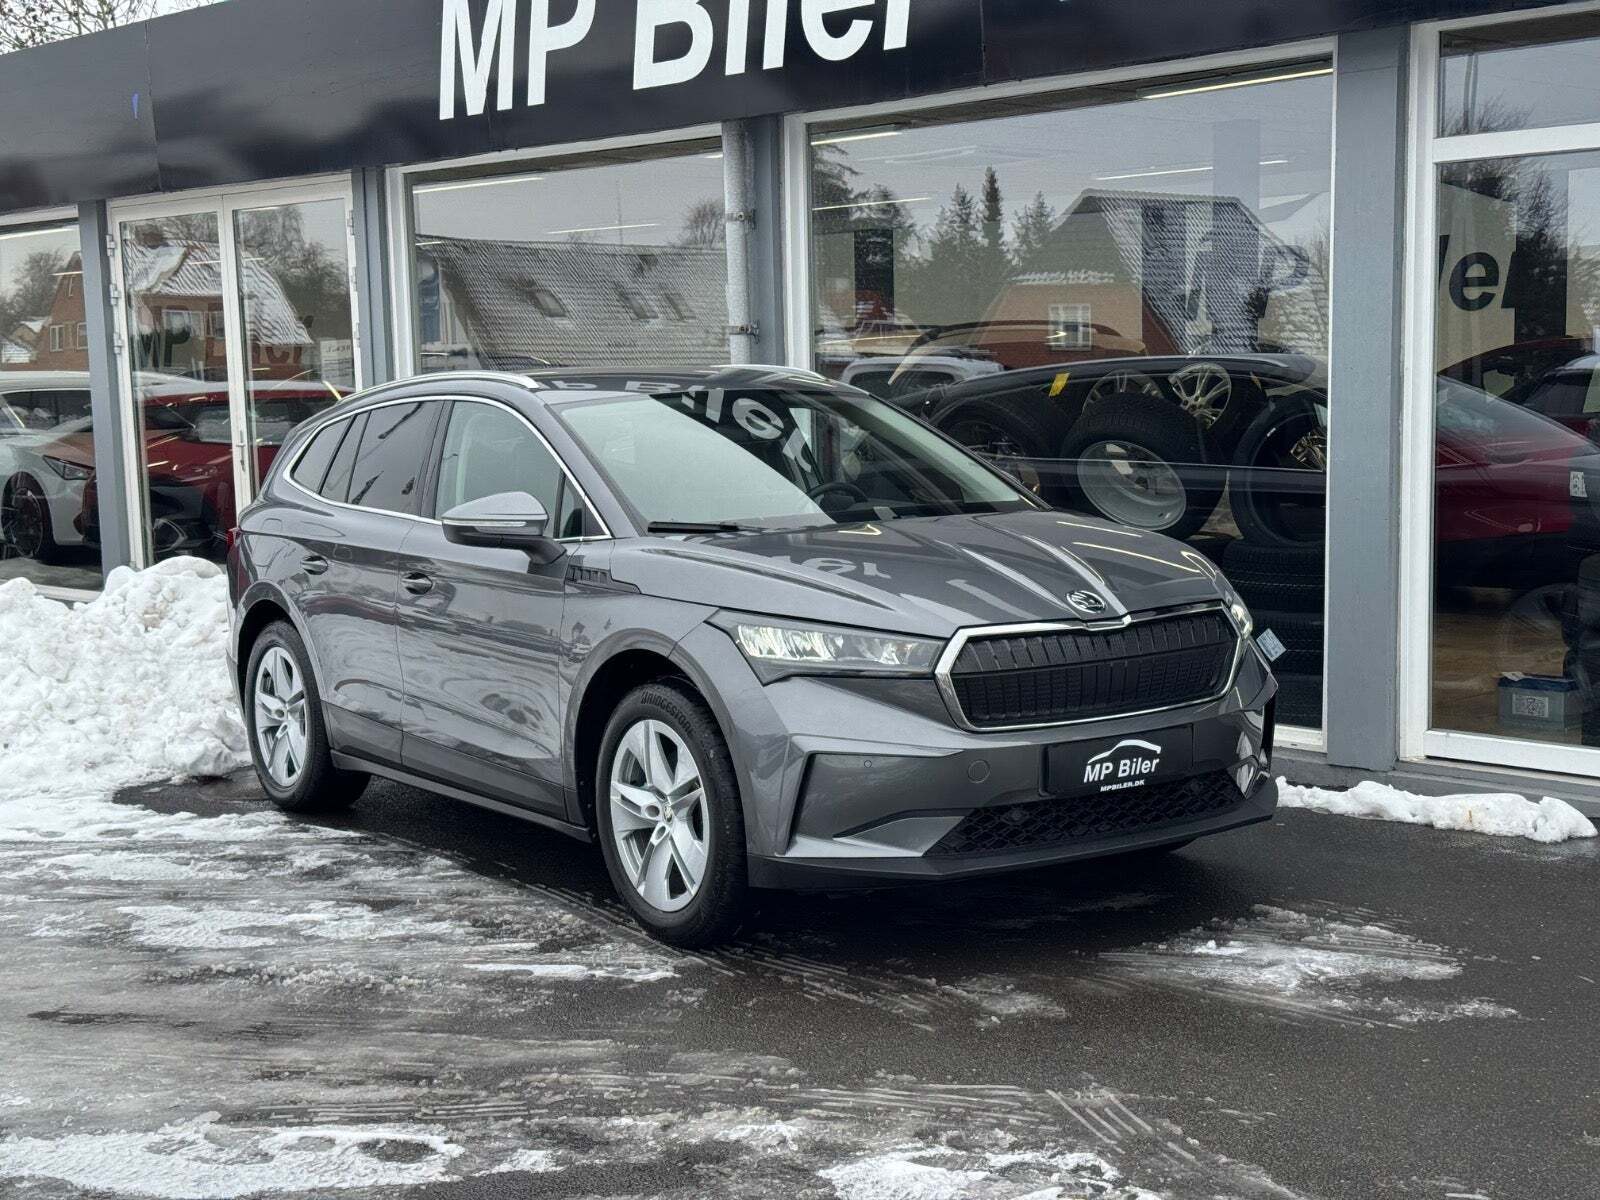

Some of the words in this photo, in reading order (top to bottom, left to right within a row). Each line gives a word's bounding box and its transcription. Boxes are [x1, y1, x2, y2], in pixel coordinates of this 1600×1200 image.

[440, 0, 597, 121] MP
[1084, 763, 1113, 783] MP
[1118, 757, 1159, 777] Biler
[1100, 780, 1144, 792] MPBILER.DK
